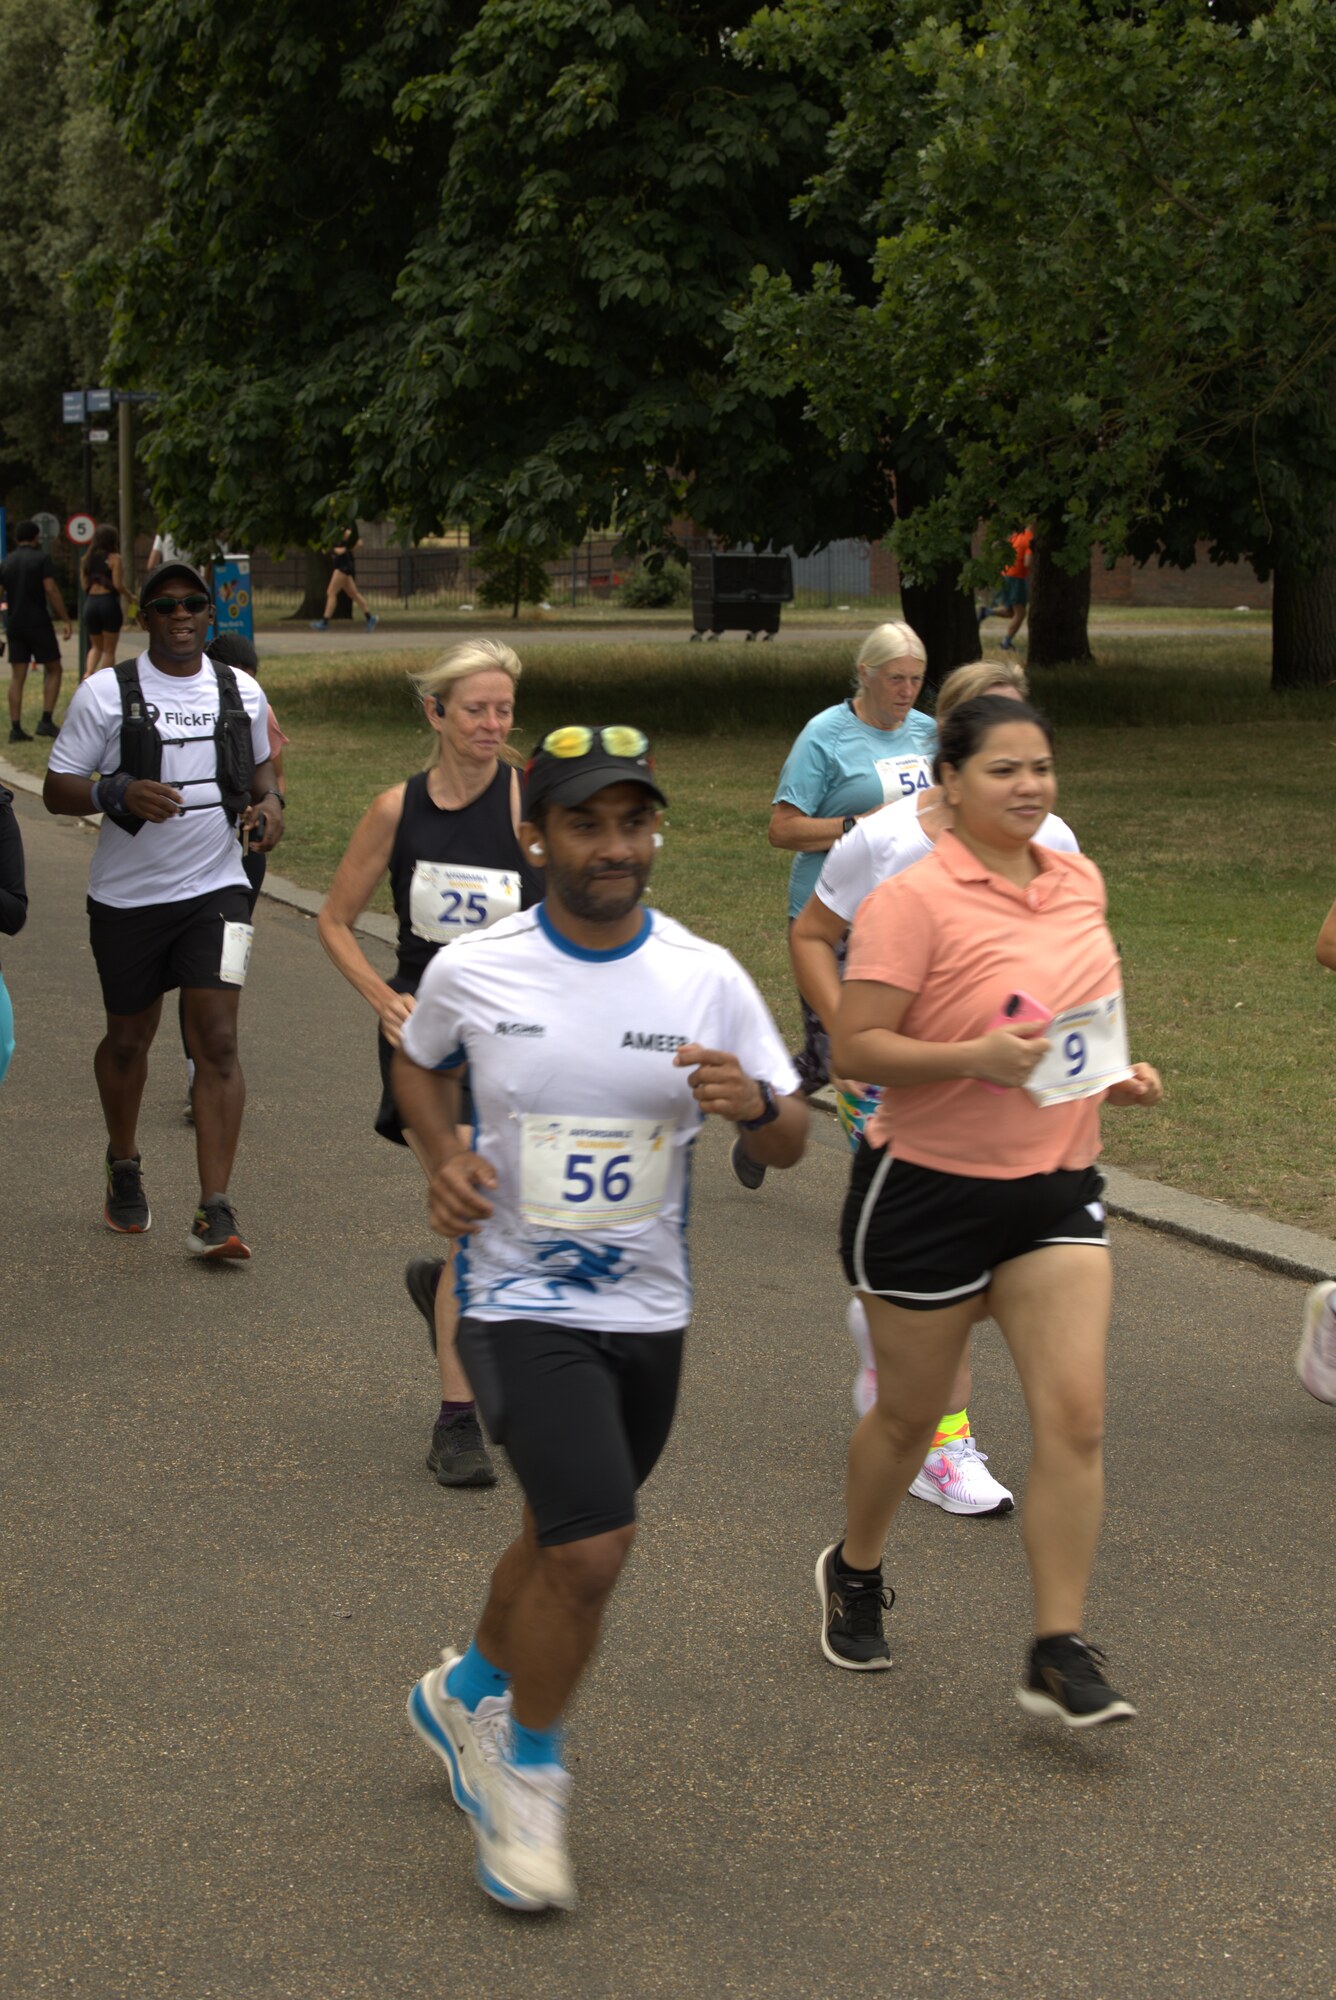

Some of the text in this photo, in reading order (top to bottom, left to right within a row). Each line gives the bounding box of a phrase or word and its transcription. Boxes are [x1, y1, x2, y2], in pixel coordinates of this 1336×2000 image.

[77, 522, 87, 536] 5
[164, 711, 220, 727] FlickFi
[898, 769, 931, 797] 54
[438, 888, 489, 926] 25
[1063, 1031, 1088, 1079] 9
[562, 1153, 634, 1204] 56
